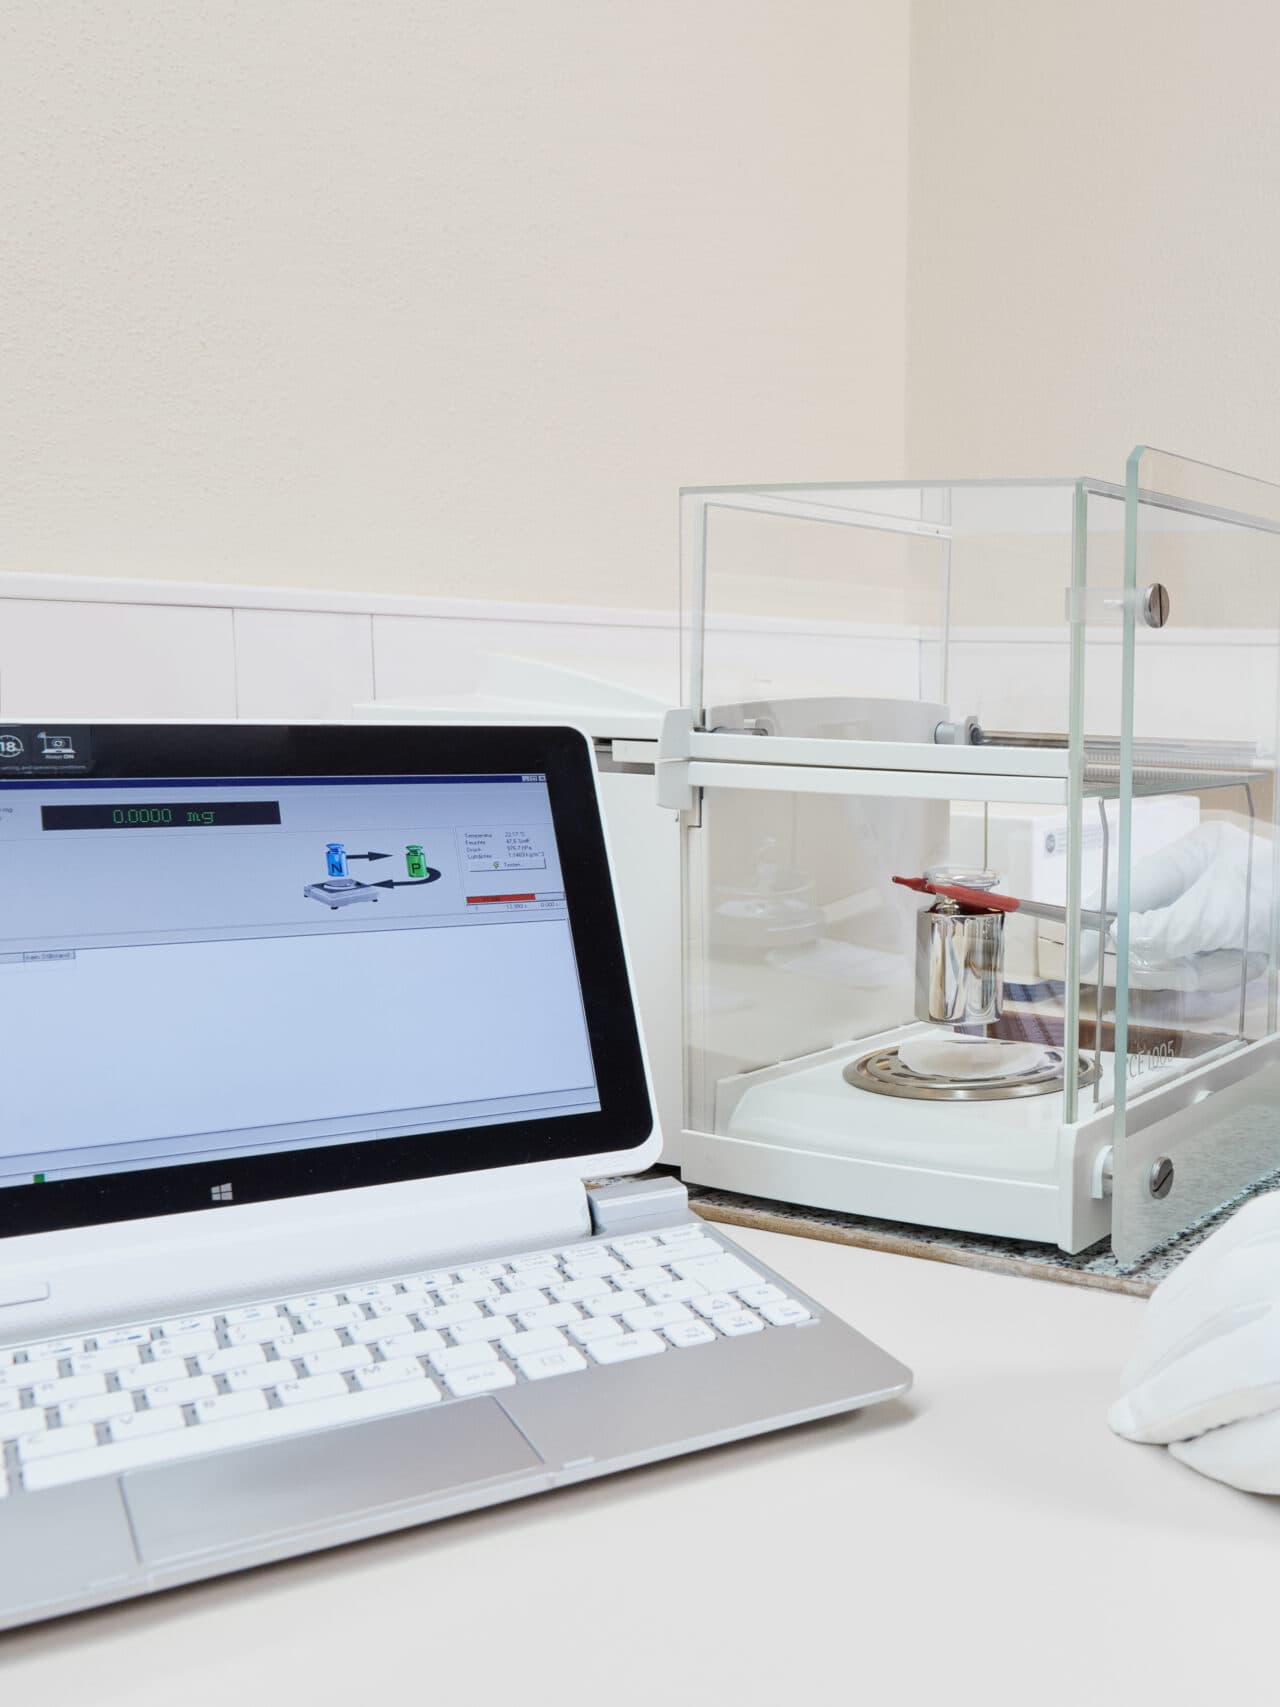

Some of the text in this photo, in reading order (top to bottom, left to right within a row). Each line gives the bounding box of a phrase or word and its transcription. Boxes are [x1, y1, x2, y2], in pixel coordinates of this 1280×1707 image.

[112, 808, 215, 824] 0.0000 mg
[330, 862, 343, 874] N
[411, 863, 422, 874] P
